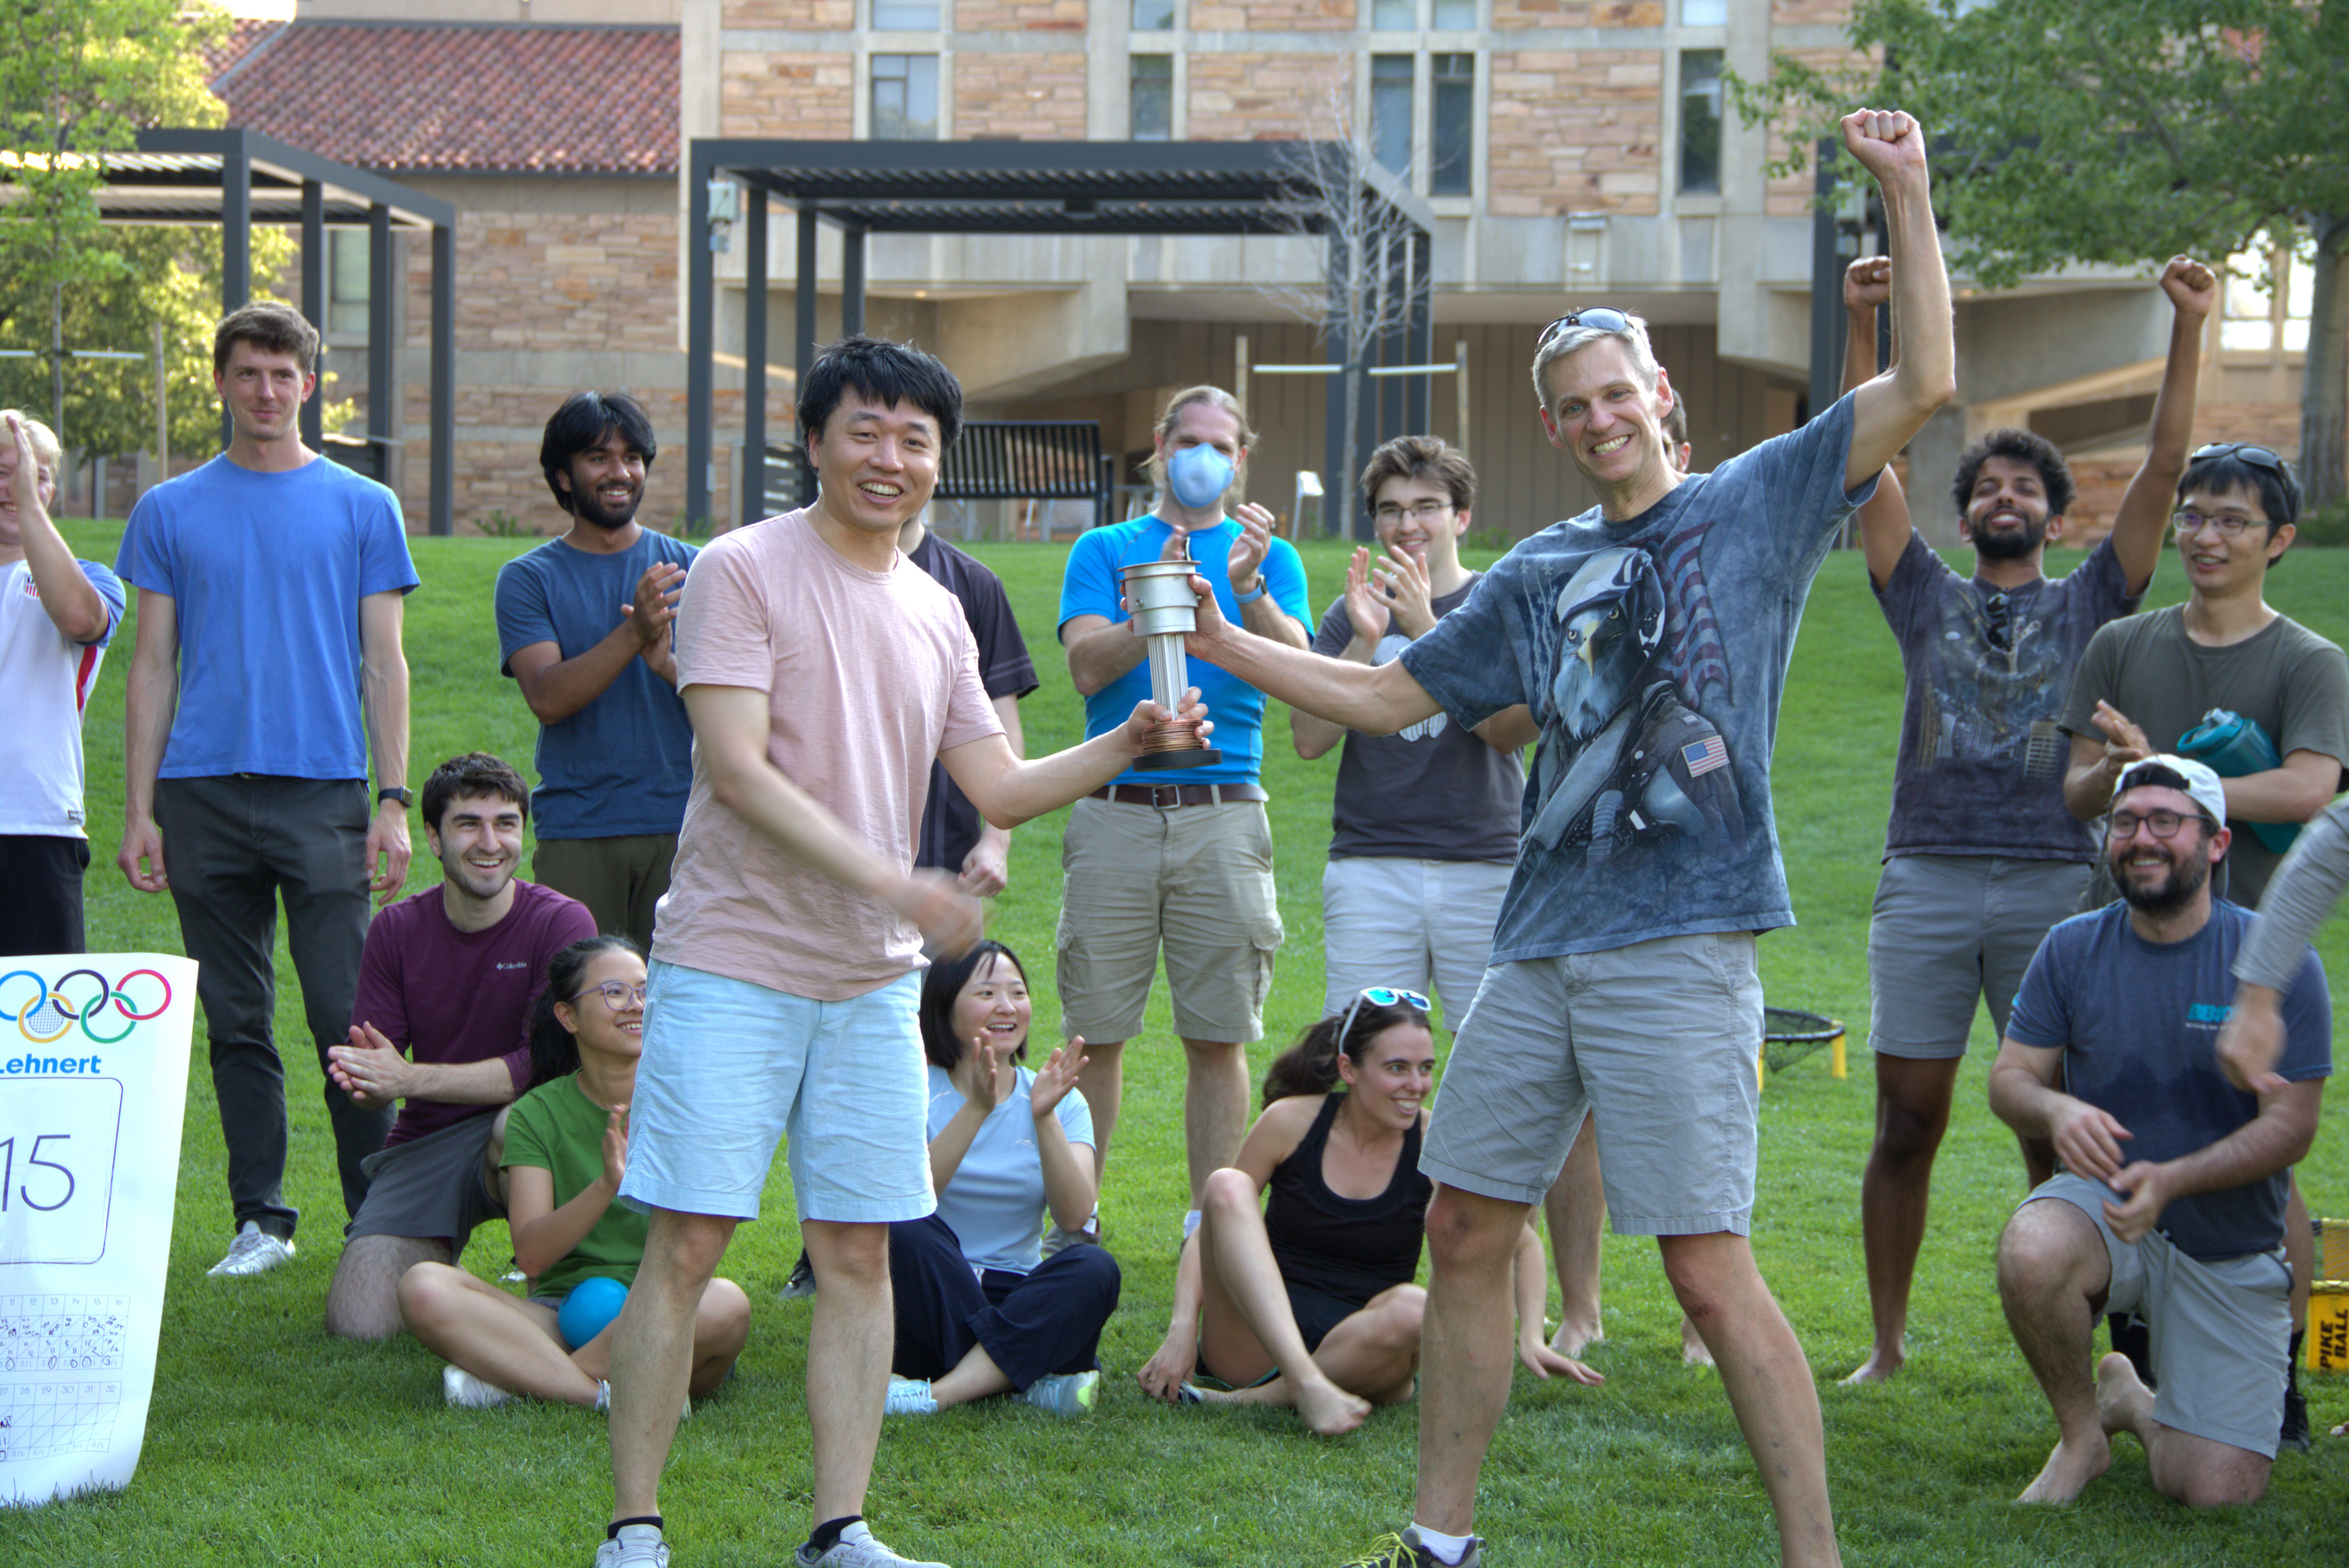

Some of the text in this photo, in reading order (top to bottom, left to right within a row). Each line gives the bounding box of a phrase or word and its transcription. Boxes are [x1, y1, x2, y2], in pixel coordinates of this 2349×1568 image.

[0, 1134, 74, 1212] 15
[50, 1297, 58, 1305] 13
[2320, 1320, 2333, 1370] PIKE
[2335, 1309, 2347, 1359] BALL
[61, 1386, 74, 1394] 30
[106, 1385, 115, 1393] 32
